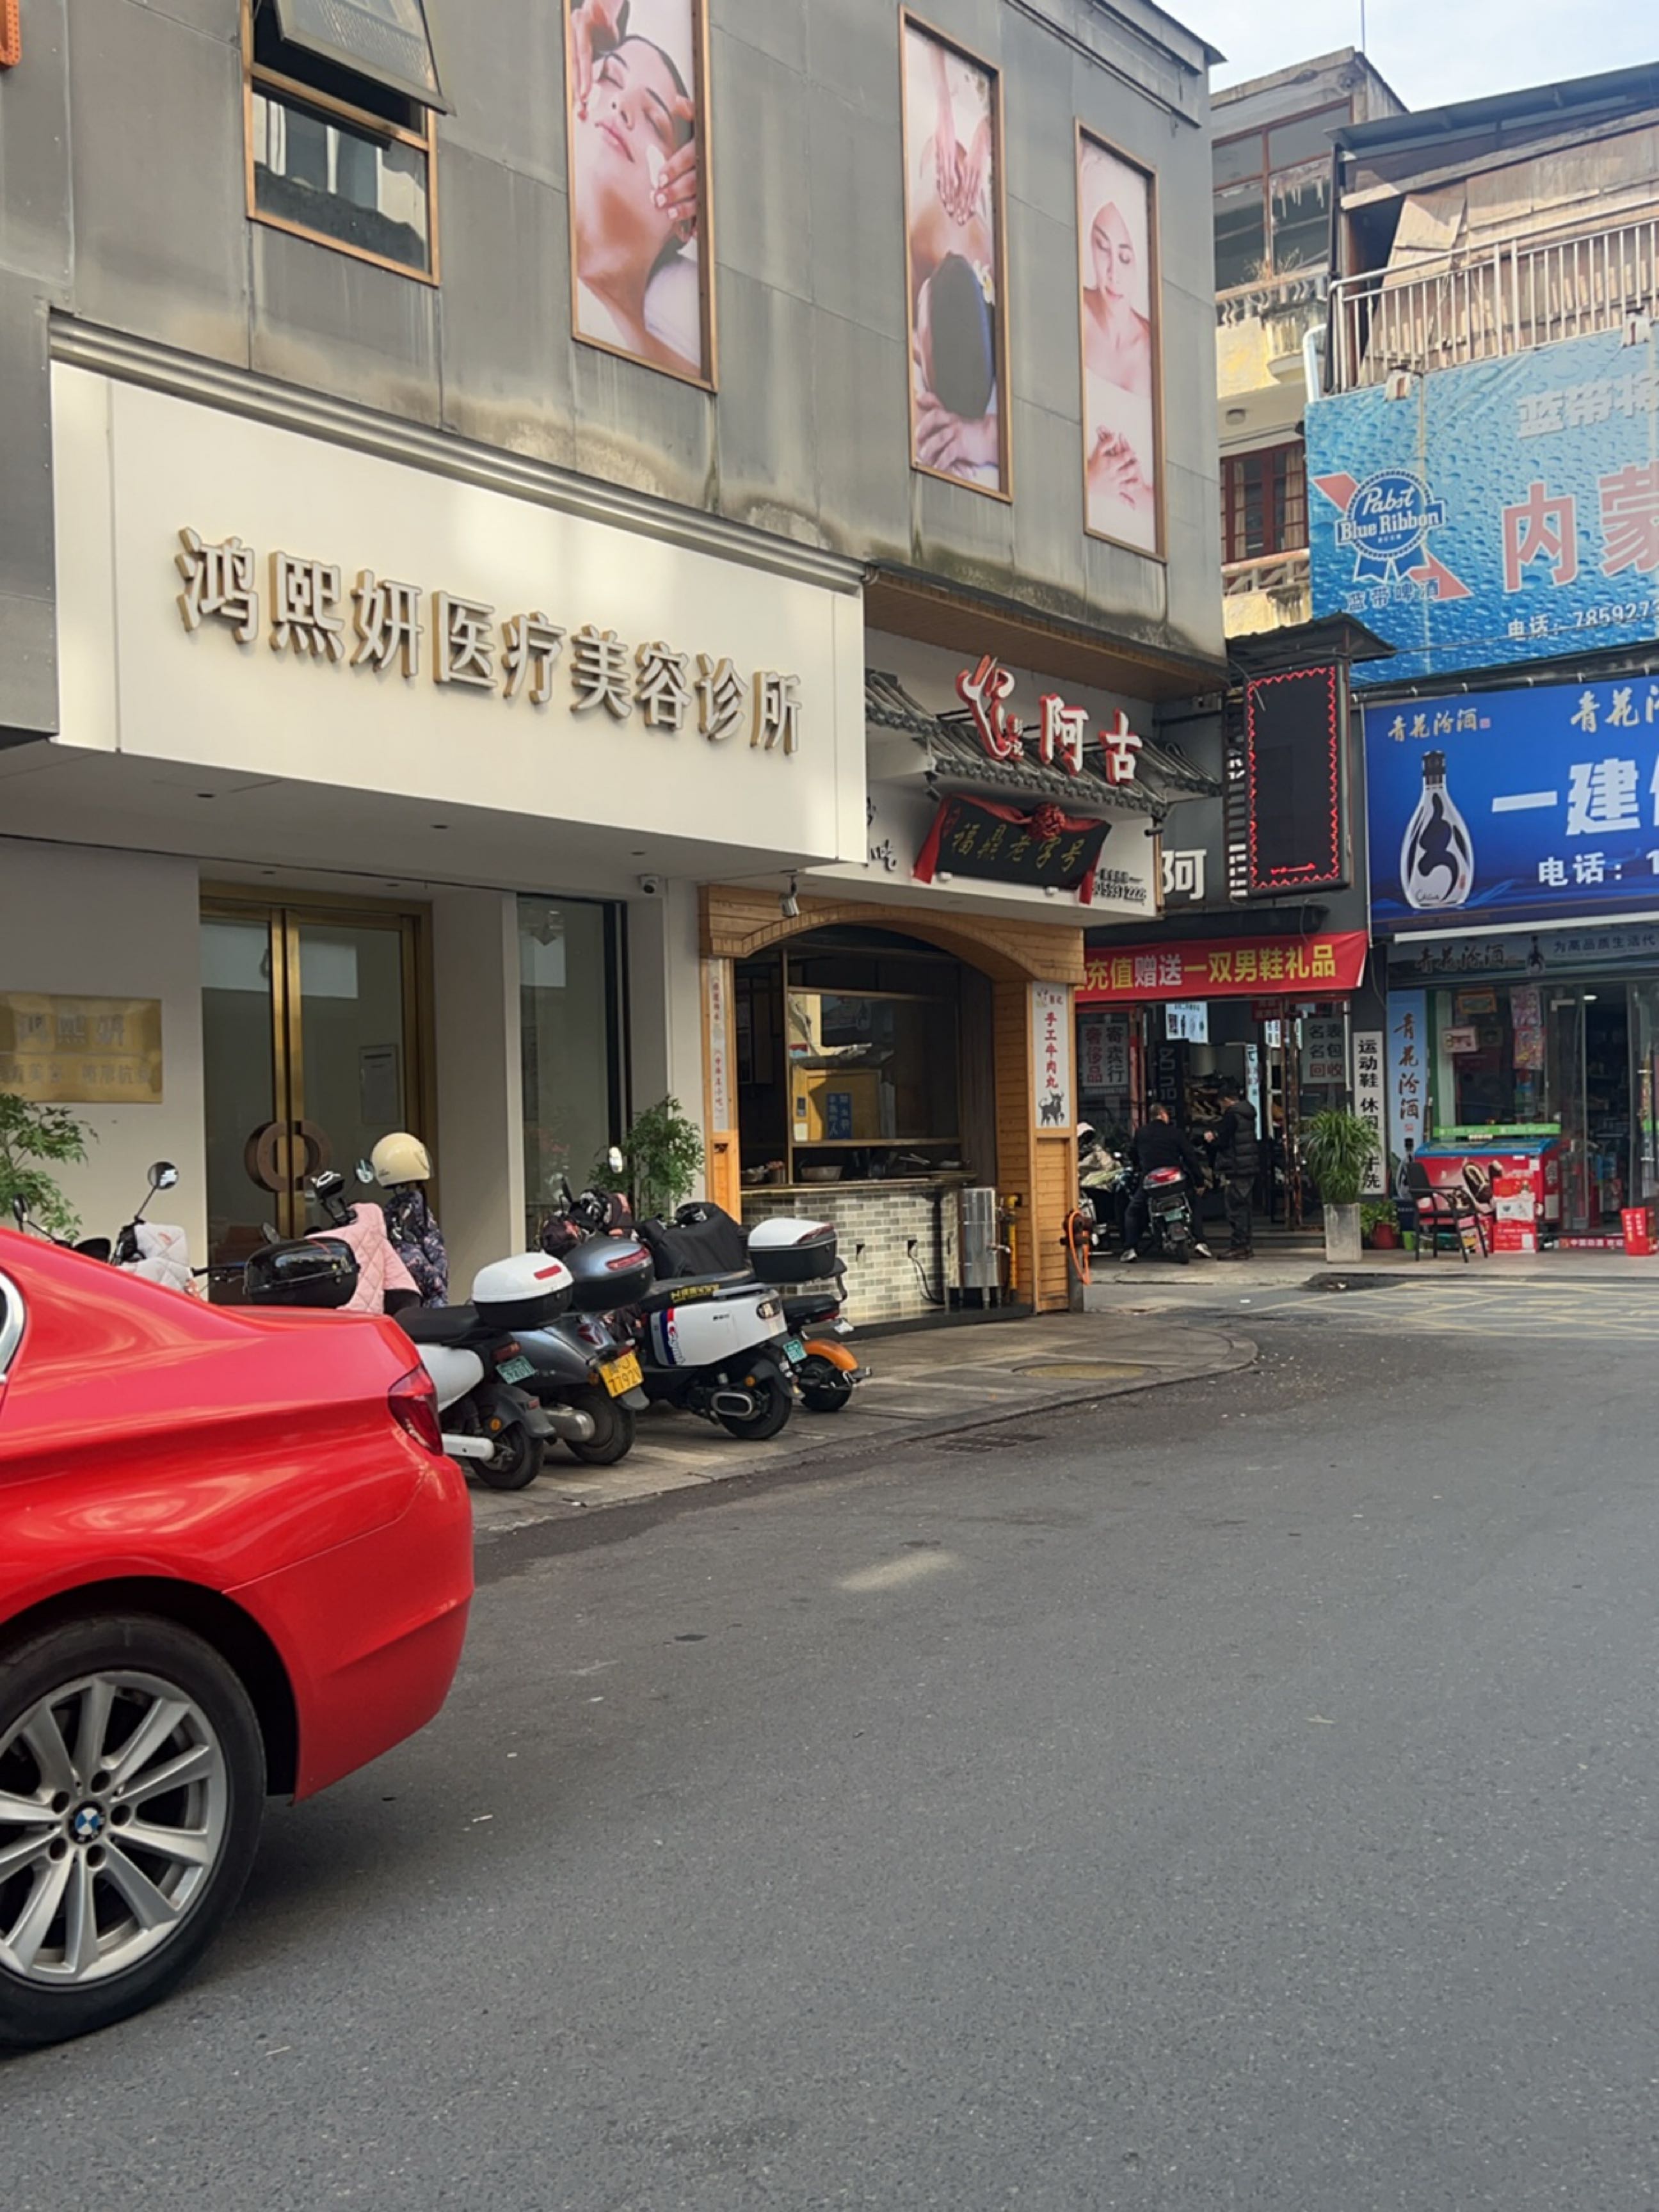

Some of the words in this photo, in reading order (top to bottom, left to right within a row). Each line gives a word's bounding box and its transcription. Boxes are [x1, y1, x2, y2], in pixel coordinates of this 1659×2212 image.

[1362, 485, 1416, 517] Pabst
[1340, 519, 1377, 541] Blue
[1379, 509, 1440, 536] Ribbon
[175, 526, 802, 755] 鸿熙妍医疗美容诊所
[1040, 692, 1142, 786] 阿古
[1388, 708, 1478, 742] 青花汾酒
[1538, 852, 1623, 887] 电话：
[1075, 945, 1336, 992] 充值赠送一双男鞋礼品
[1309, 1025, 1342, 1039] 名表
[1044, 1011, 1059, 1089] 手工牛肉丸
[1309, 1044, 1343, 1059] 名包
[1358, 1039, 1379, 1088] 运动鞋
[1393, 1012, 1420, 1114] 青花汾酒
[1309, 1062, 1343, 1078] 回收
